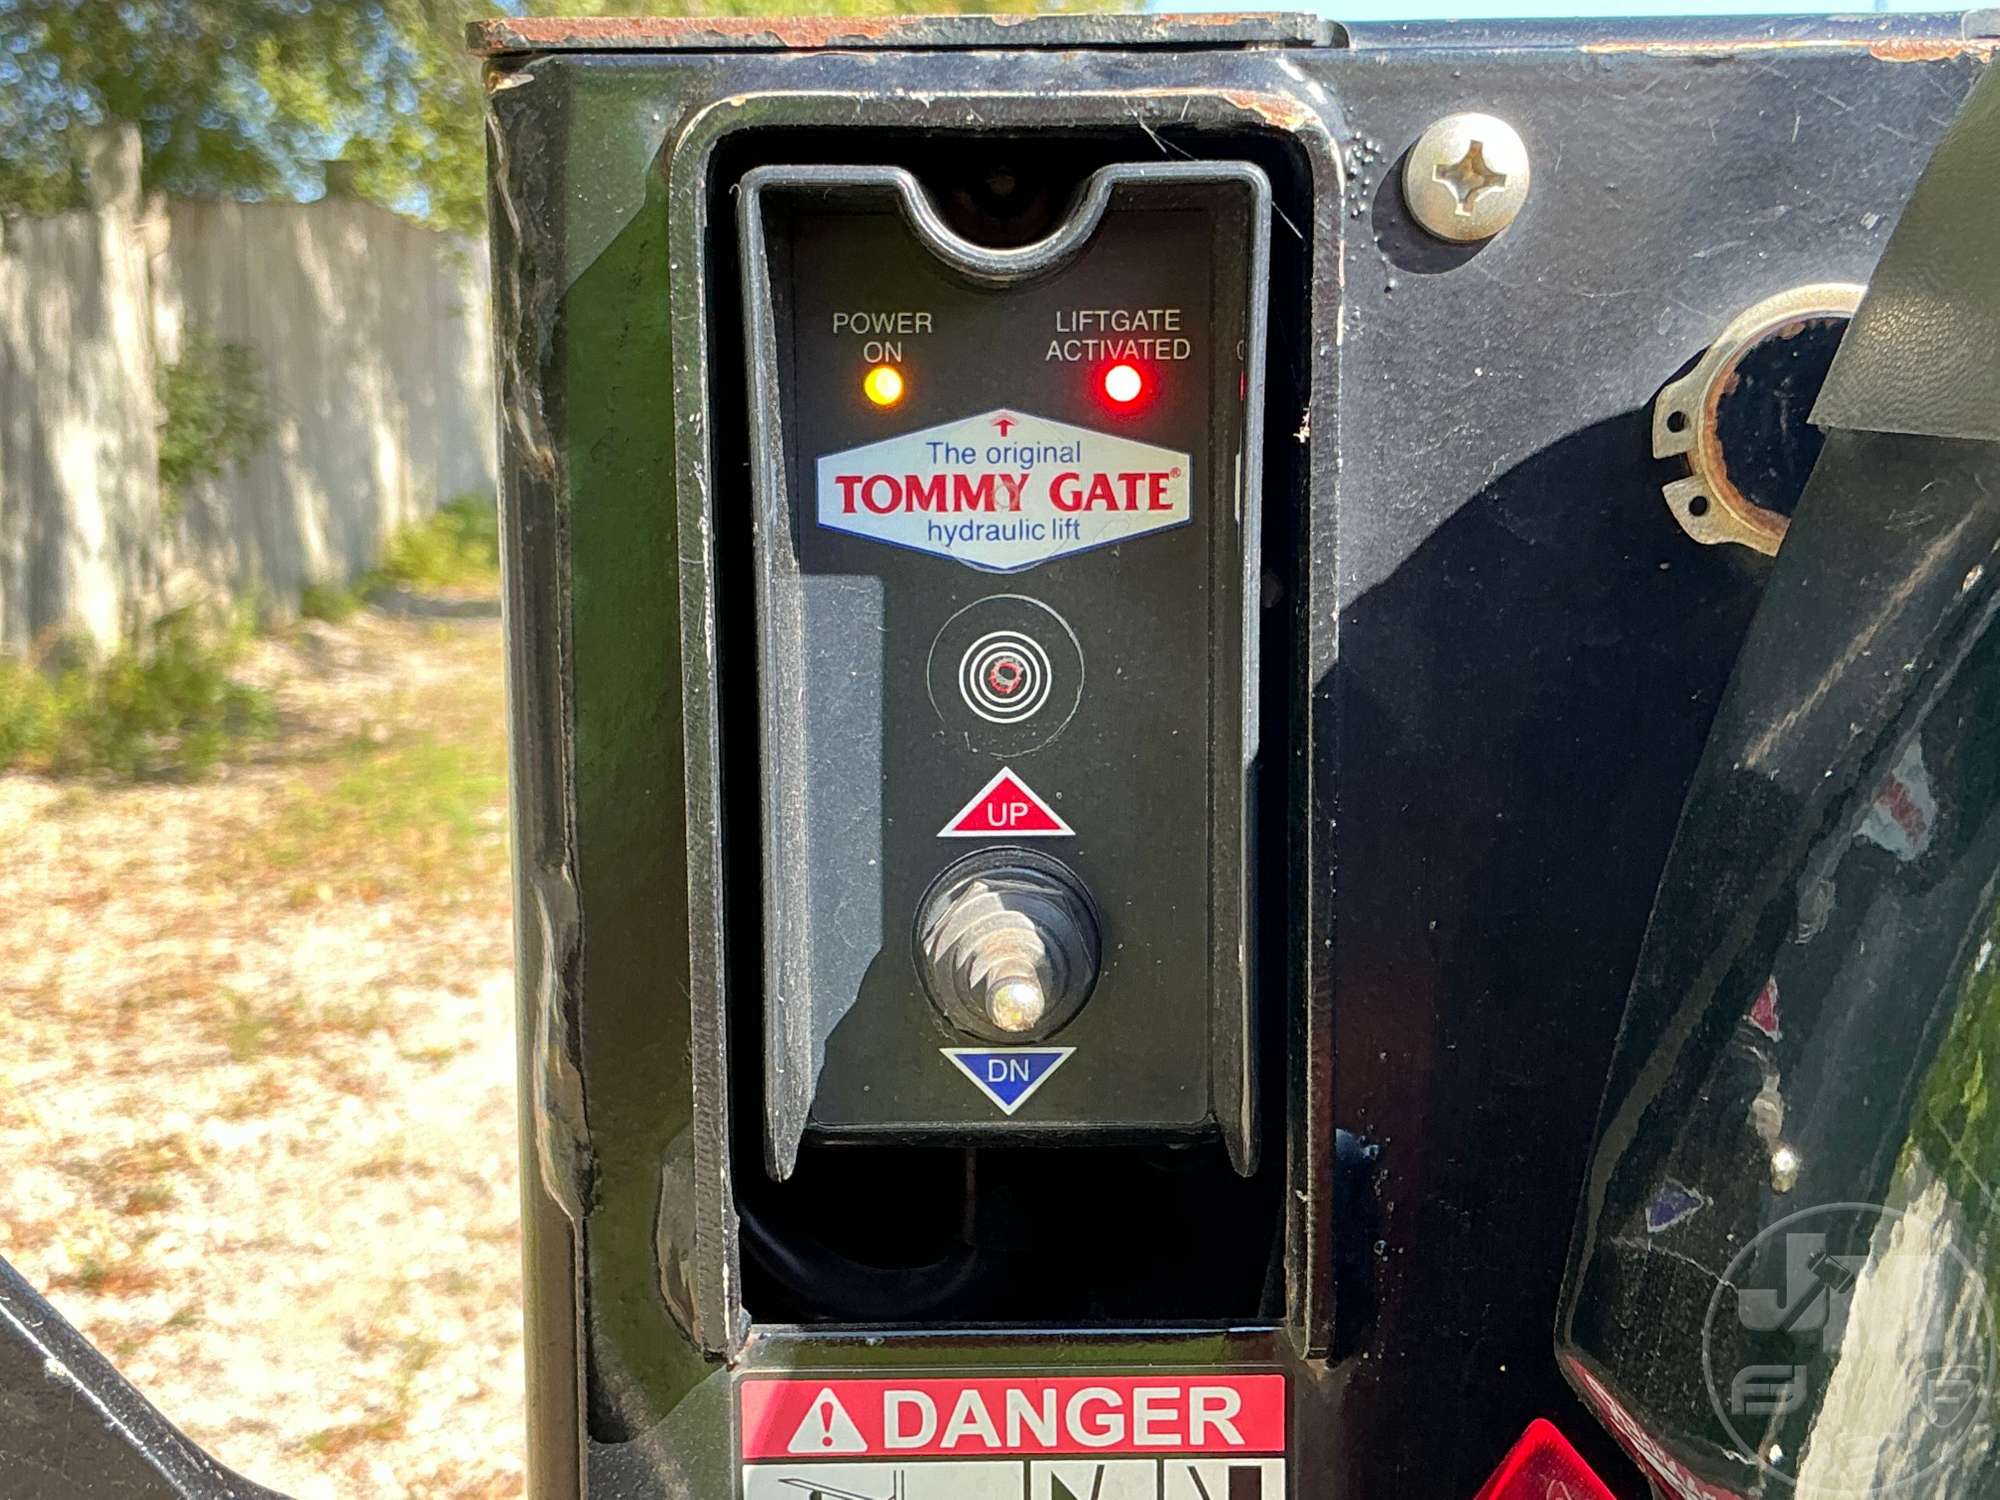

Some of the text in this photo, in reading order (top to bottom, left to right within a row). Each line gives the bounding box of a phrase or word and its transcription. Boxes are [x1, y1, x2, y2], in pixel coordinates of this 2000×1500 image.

[832, 312, 933, 335] POWER
[1055, 308, 1182, 333] LIFTGATE
[863, 341, 903, 364] ON
[1045, 338, 1191, 362] ACTIVATED
[926, 440, 1082, 470] The original
[834, 473, 1030, 514] TOMMY
[927, 518, 1081, 545] hydraulic lift
[986, 801, 1030, 827] UP
[987, 1058, 1030, 1083] DN
[882, 1386, 1246, 1449] DANGER
